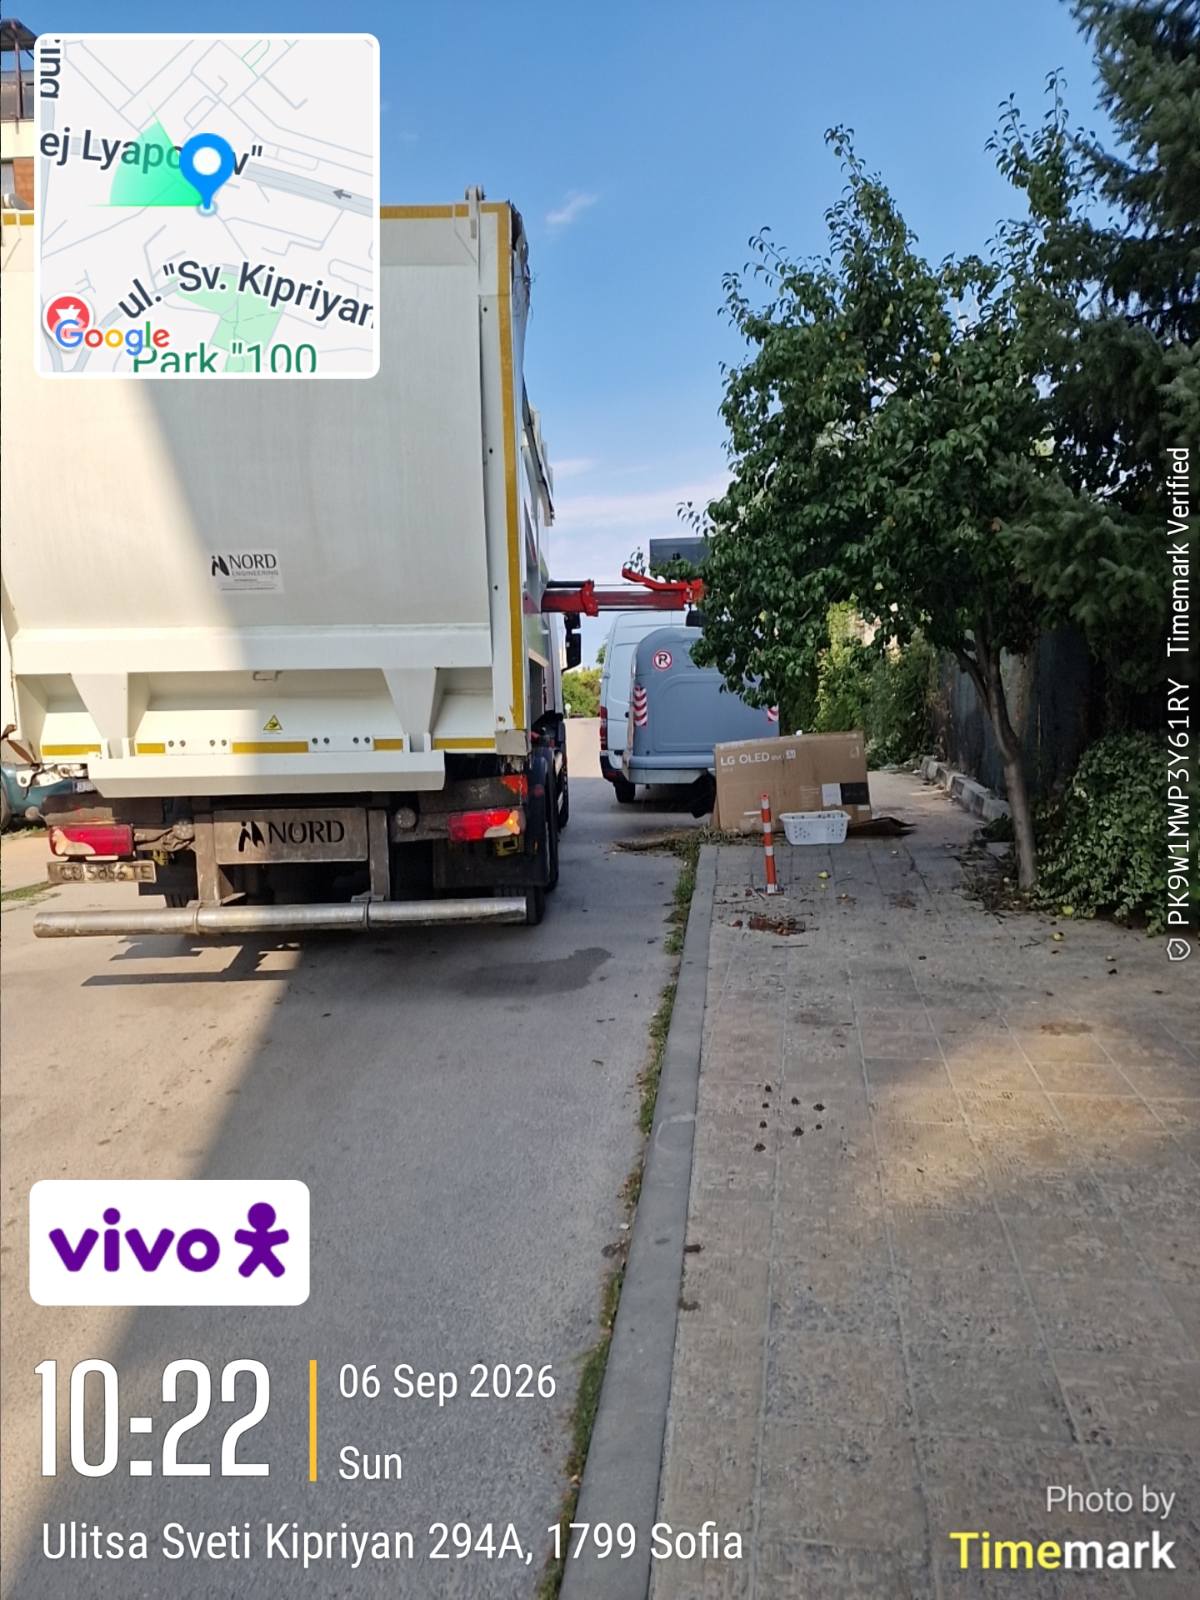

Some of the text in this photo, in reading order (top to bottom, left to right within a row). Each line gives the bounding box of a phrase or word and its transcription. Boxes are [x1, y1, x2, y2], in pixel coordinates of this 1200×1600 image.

[229, 553, 277, 569] NORD
[720, 755, 736, 766] LG
[738, 752, 770, 764] OLED
[267, 820, 345, 844] NORD
